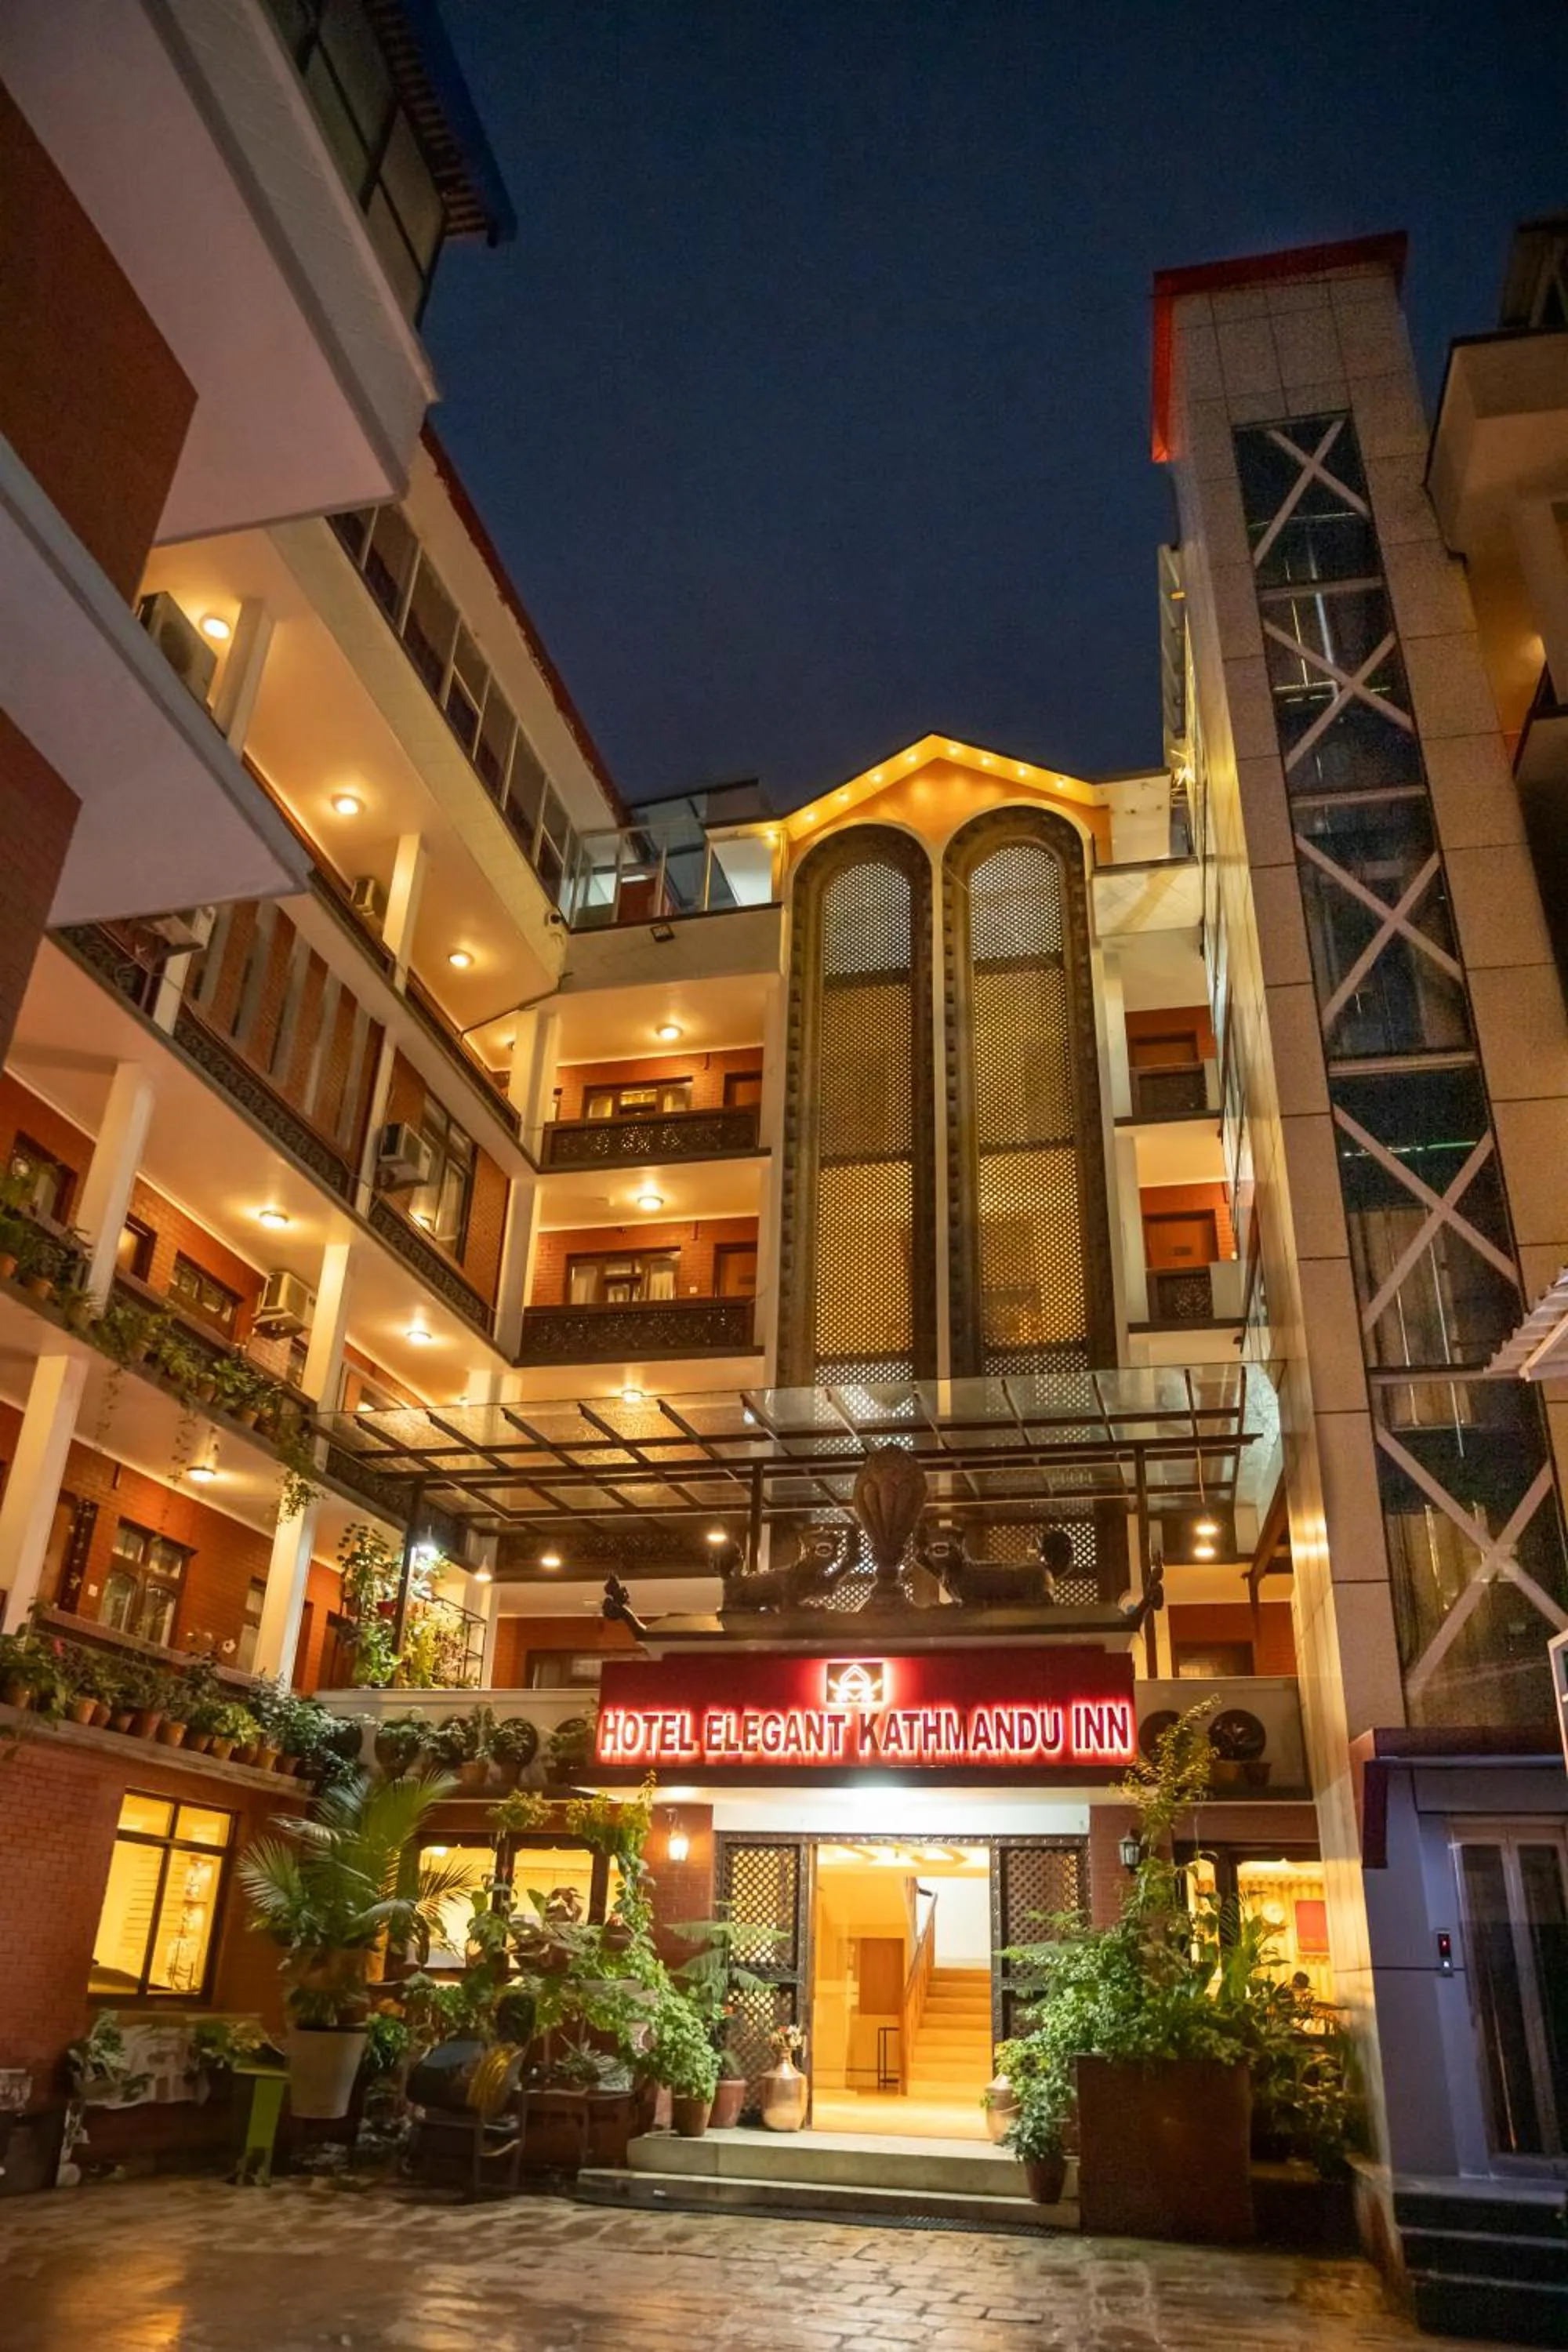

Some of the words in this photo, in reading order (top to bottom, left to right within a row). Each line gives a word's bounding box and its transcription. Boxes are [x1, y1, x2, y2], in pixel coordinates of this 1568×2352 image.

[601, 1712, 695, 1753] HOTEL
[706, 1712, 847, 1753] ELEGANT
[858, 1711, 1062, 1752] KATHMANDU
[1074, 1705, 1129, 1751] INN
